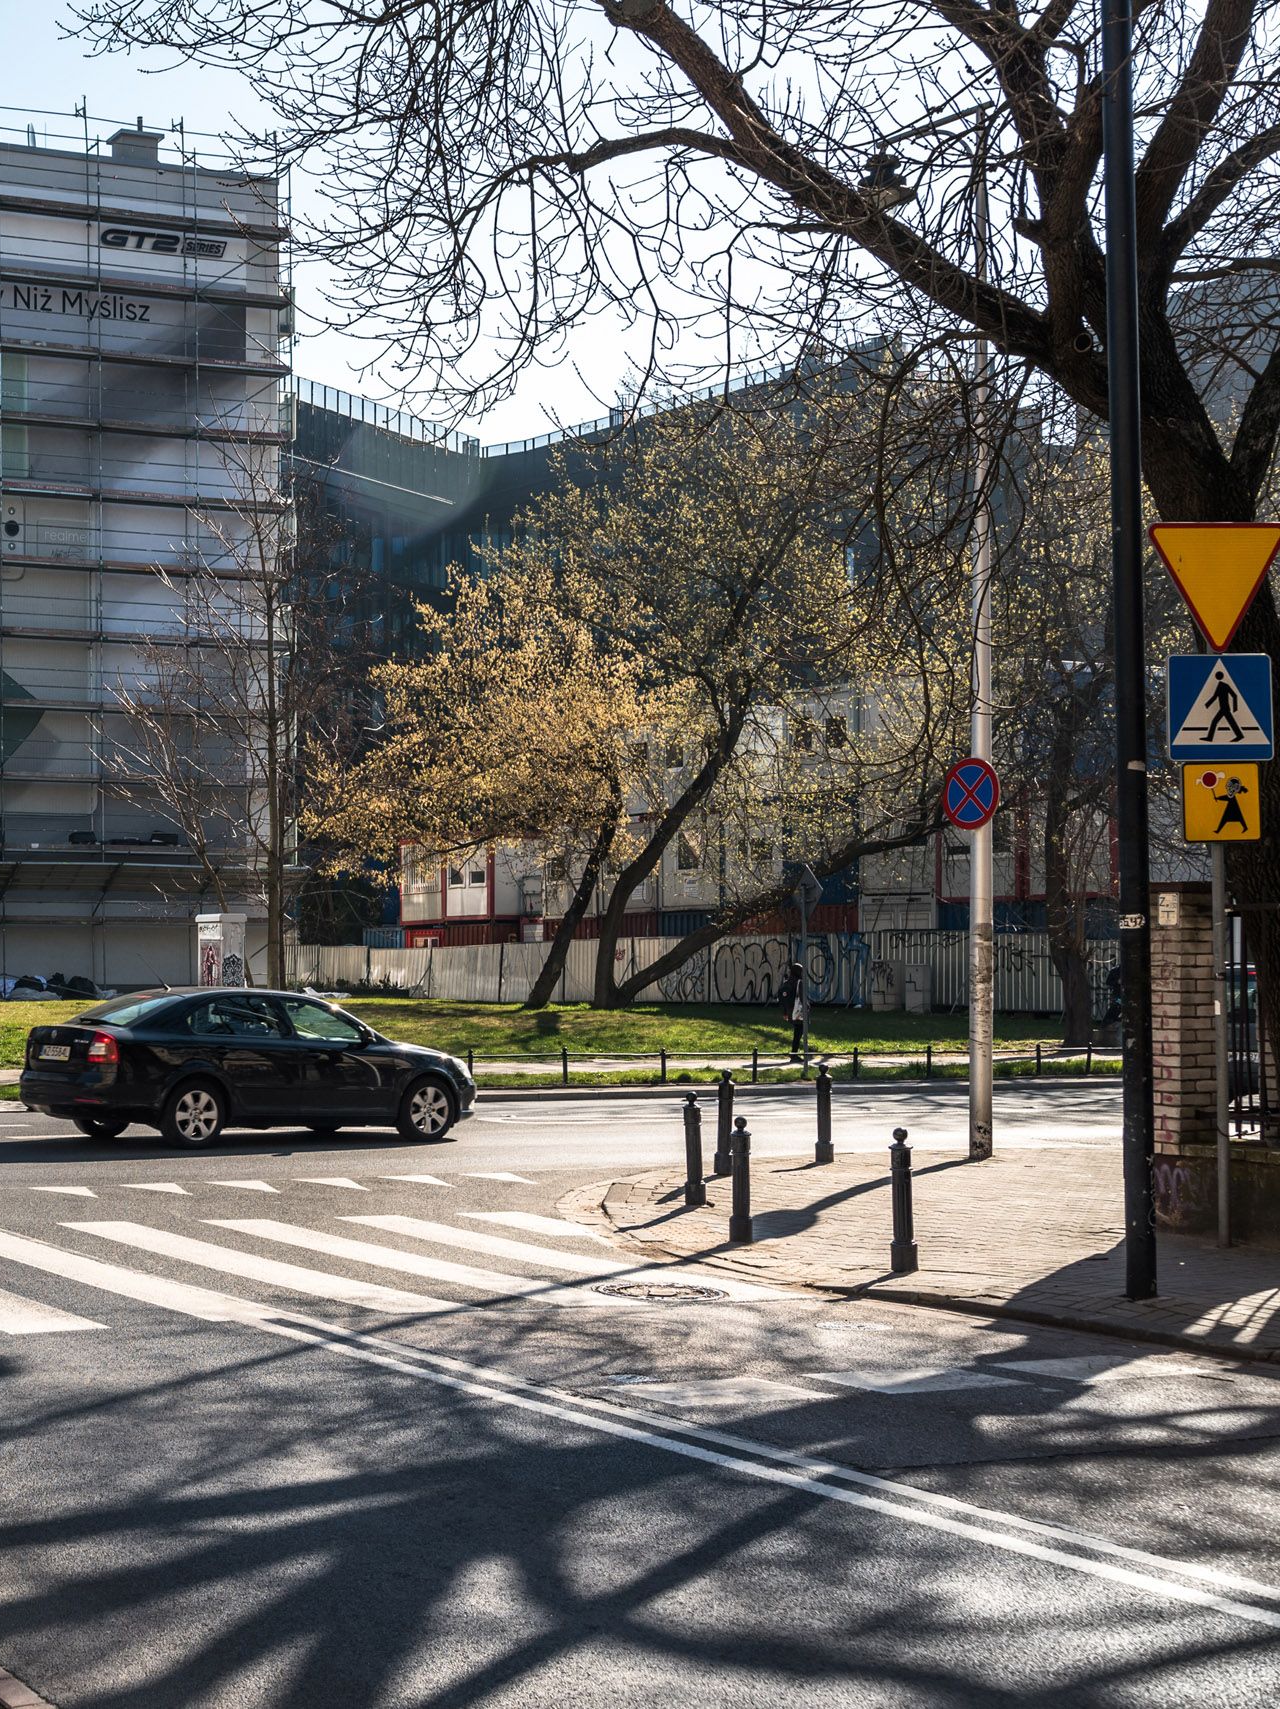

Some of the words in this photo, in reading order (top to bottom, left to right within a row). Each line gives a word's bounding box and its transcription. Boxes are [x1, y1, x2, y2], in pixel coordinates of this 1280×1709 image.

[101, 229, 180, 252] GT2
[184, 240, 223, 256] SERIES
[12, 285, 53, 312] Niż
[61, 291, 151, 323] Myślisz
